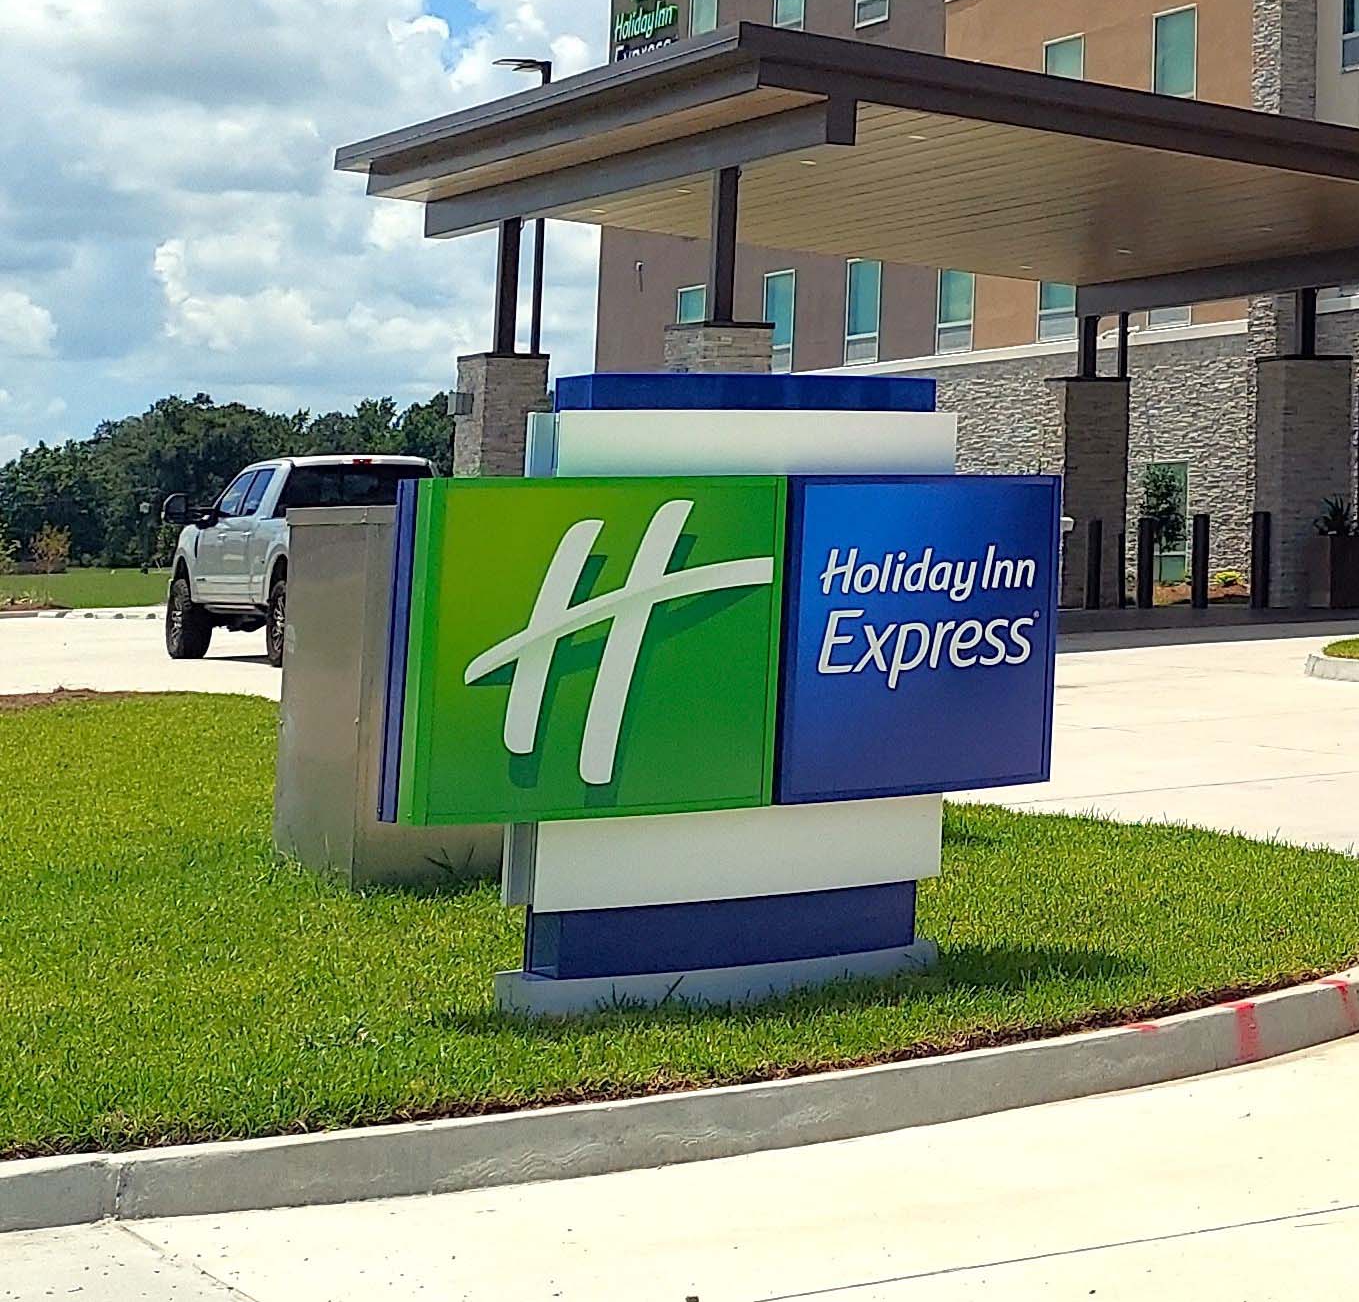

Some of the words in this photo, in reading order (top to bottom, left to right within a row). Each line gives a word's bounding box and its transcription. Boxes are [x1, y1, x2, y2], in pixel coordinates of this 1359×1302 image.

[614, 7, 655, 42] Holiday
[655, 1, 678, 28] Inn
[820, 548, 977, 601] Holiday
[982, 545, 1036, 590] Inn
[465, 499, 773, 784] H
[818, 609, 1034, 689] Express
